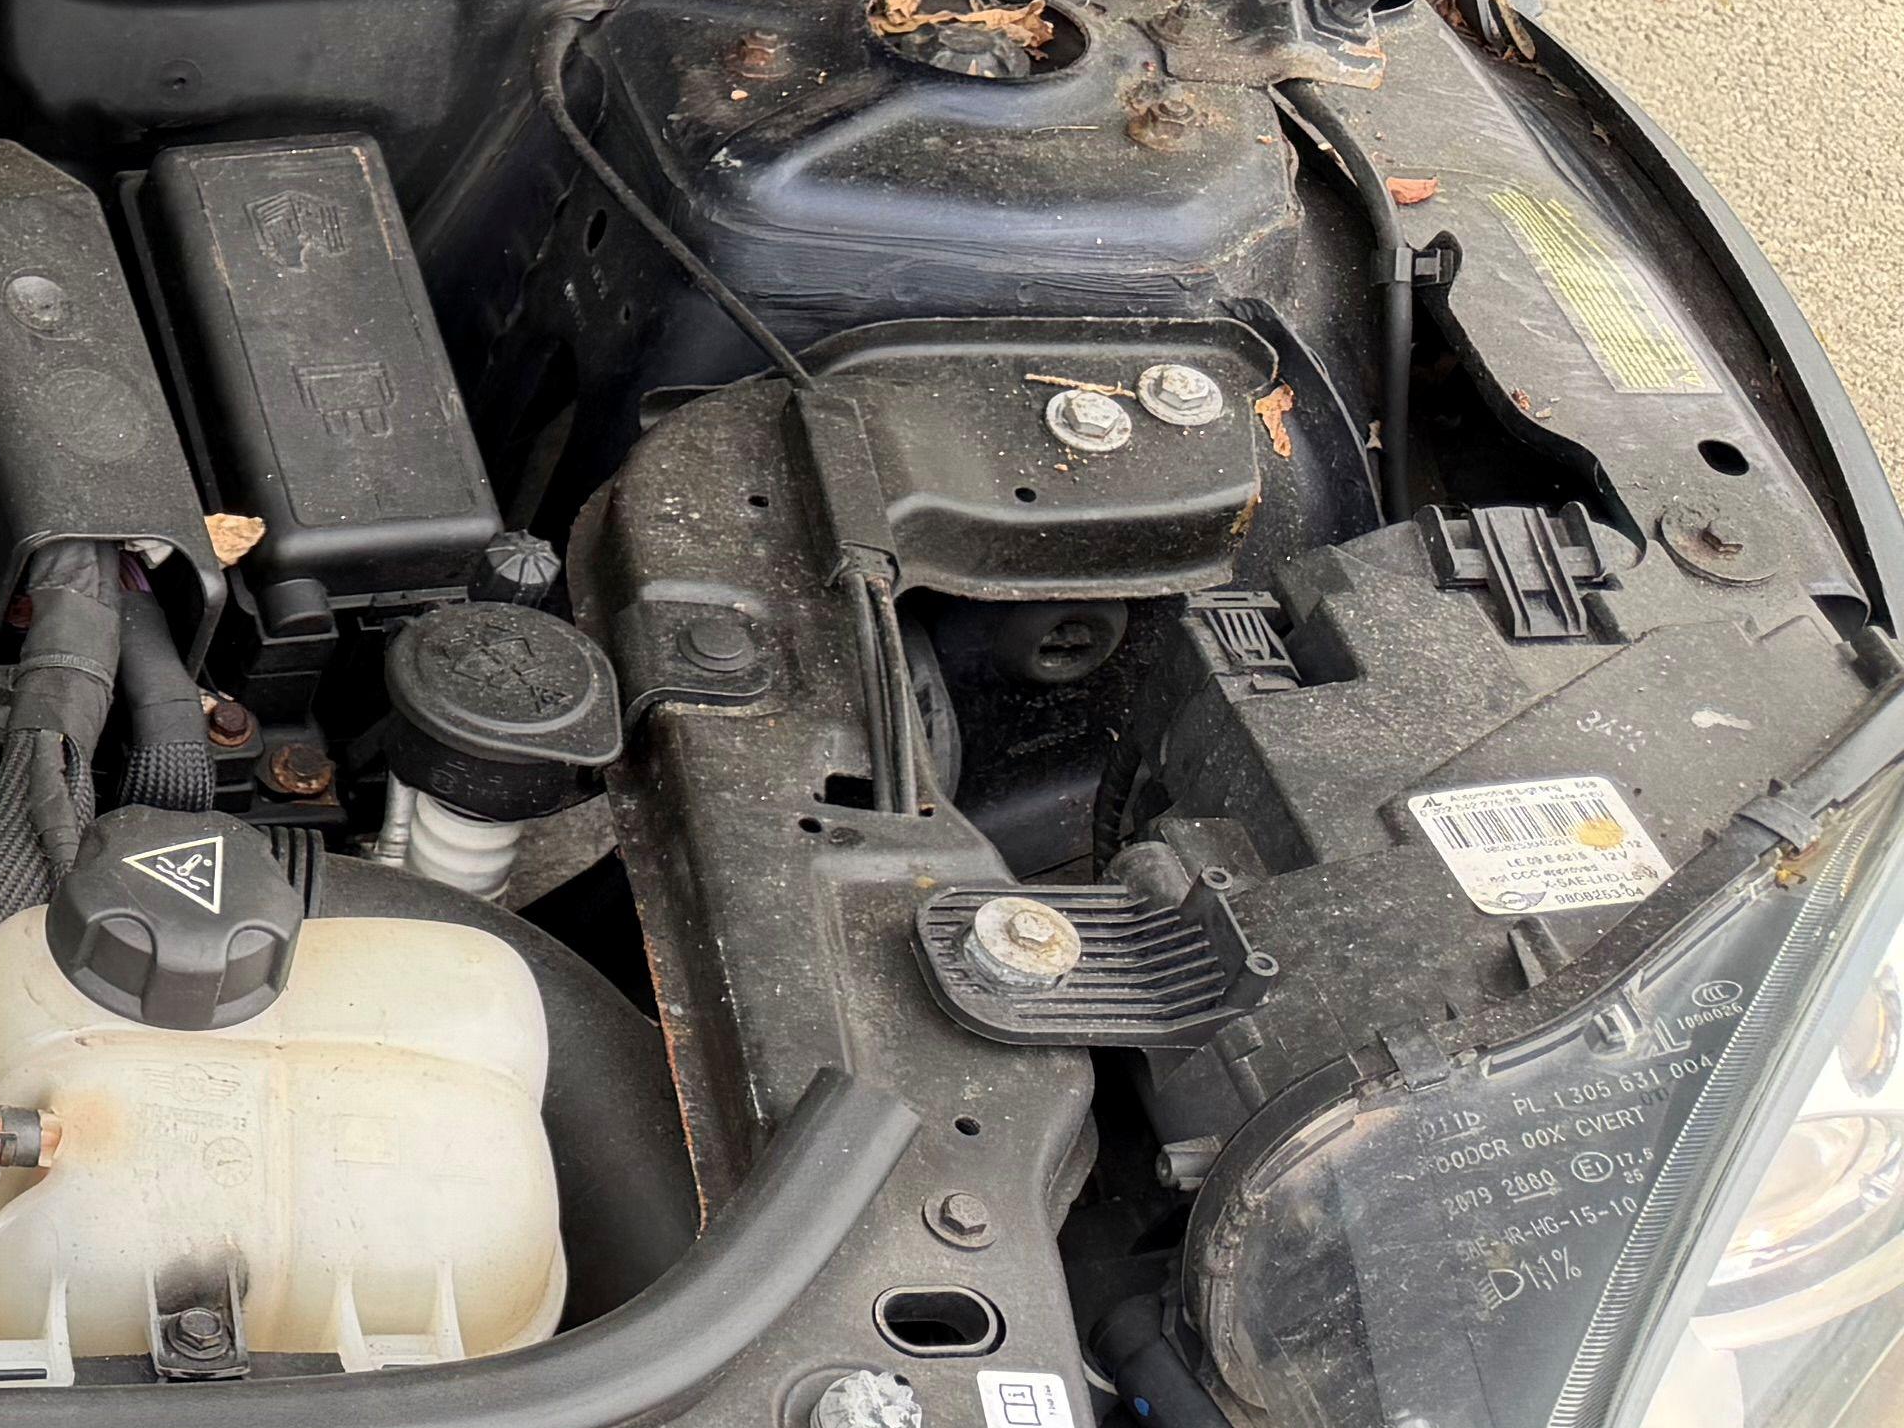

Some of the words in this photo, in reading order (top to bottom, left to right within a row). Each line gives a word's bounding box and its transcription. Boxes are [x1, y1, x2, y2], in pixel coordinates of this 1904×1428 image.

[1512, 1095, 1545, 1117] PL
[1571, 1081, 1613, 1105] 305
[1618, 1068, 1661, 1093] 631
[1575, 1105, 1647, 1138] CVERT
